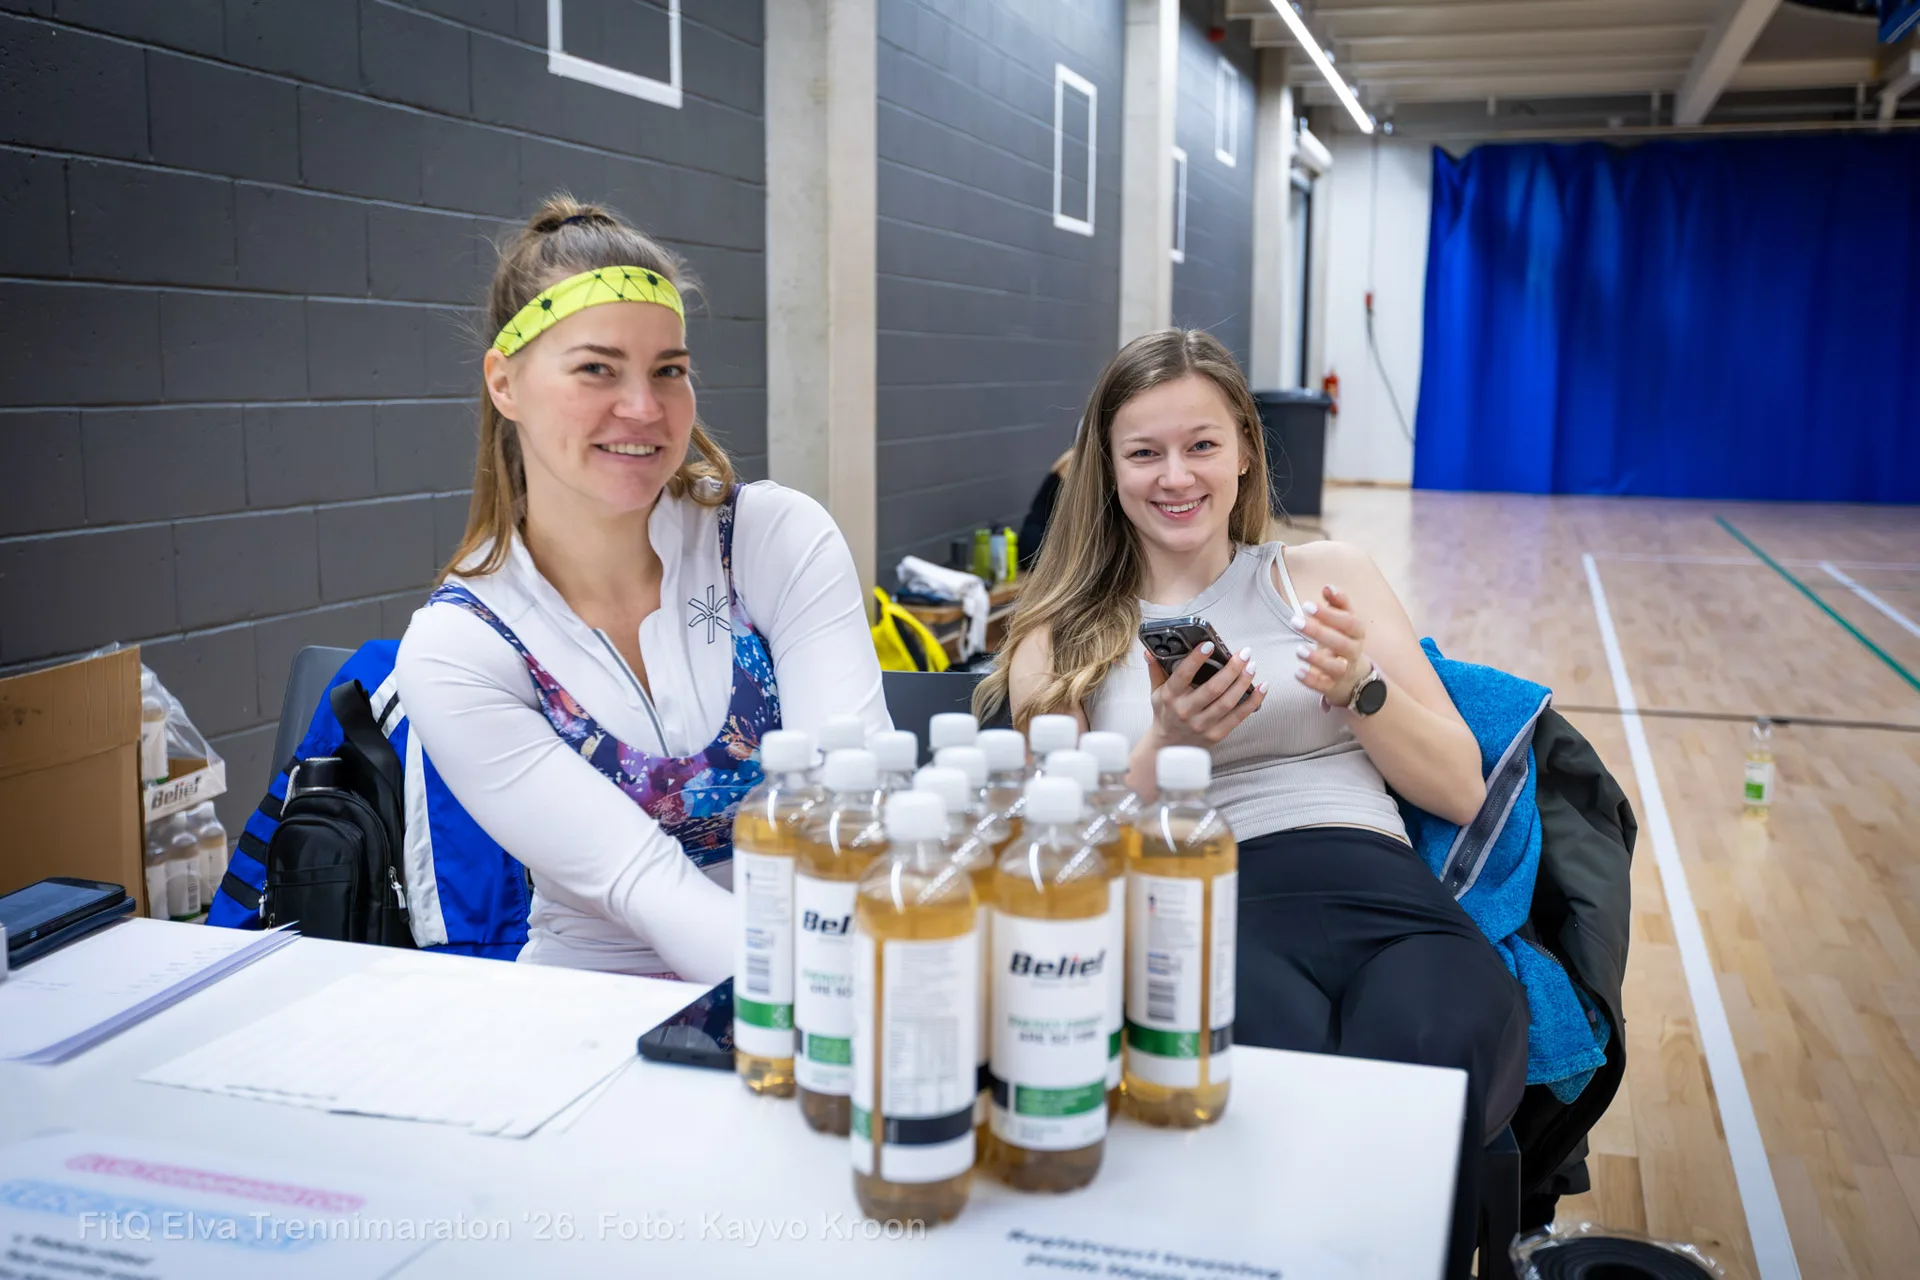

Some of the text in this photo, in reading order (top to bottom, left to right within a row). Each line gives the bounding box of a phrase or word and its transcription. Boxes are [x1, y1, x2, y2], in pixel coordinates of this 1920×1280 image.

[151, 775, 203, 811] Belief
[803, 910, 852, 936] Bel
[1009, 947, 1107, 979] Belief
